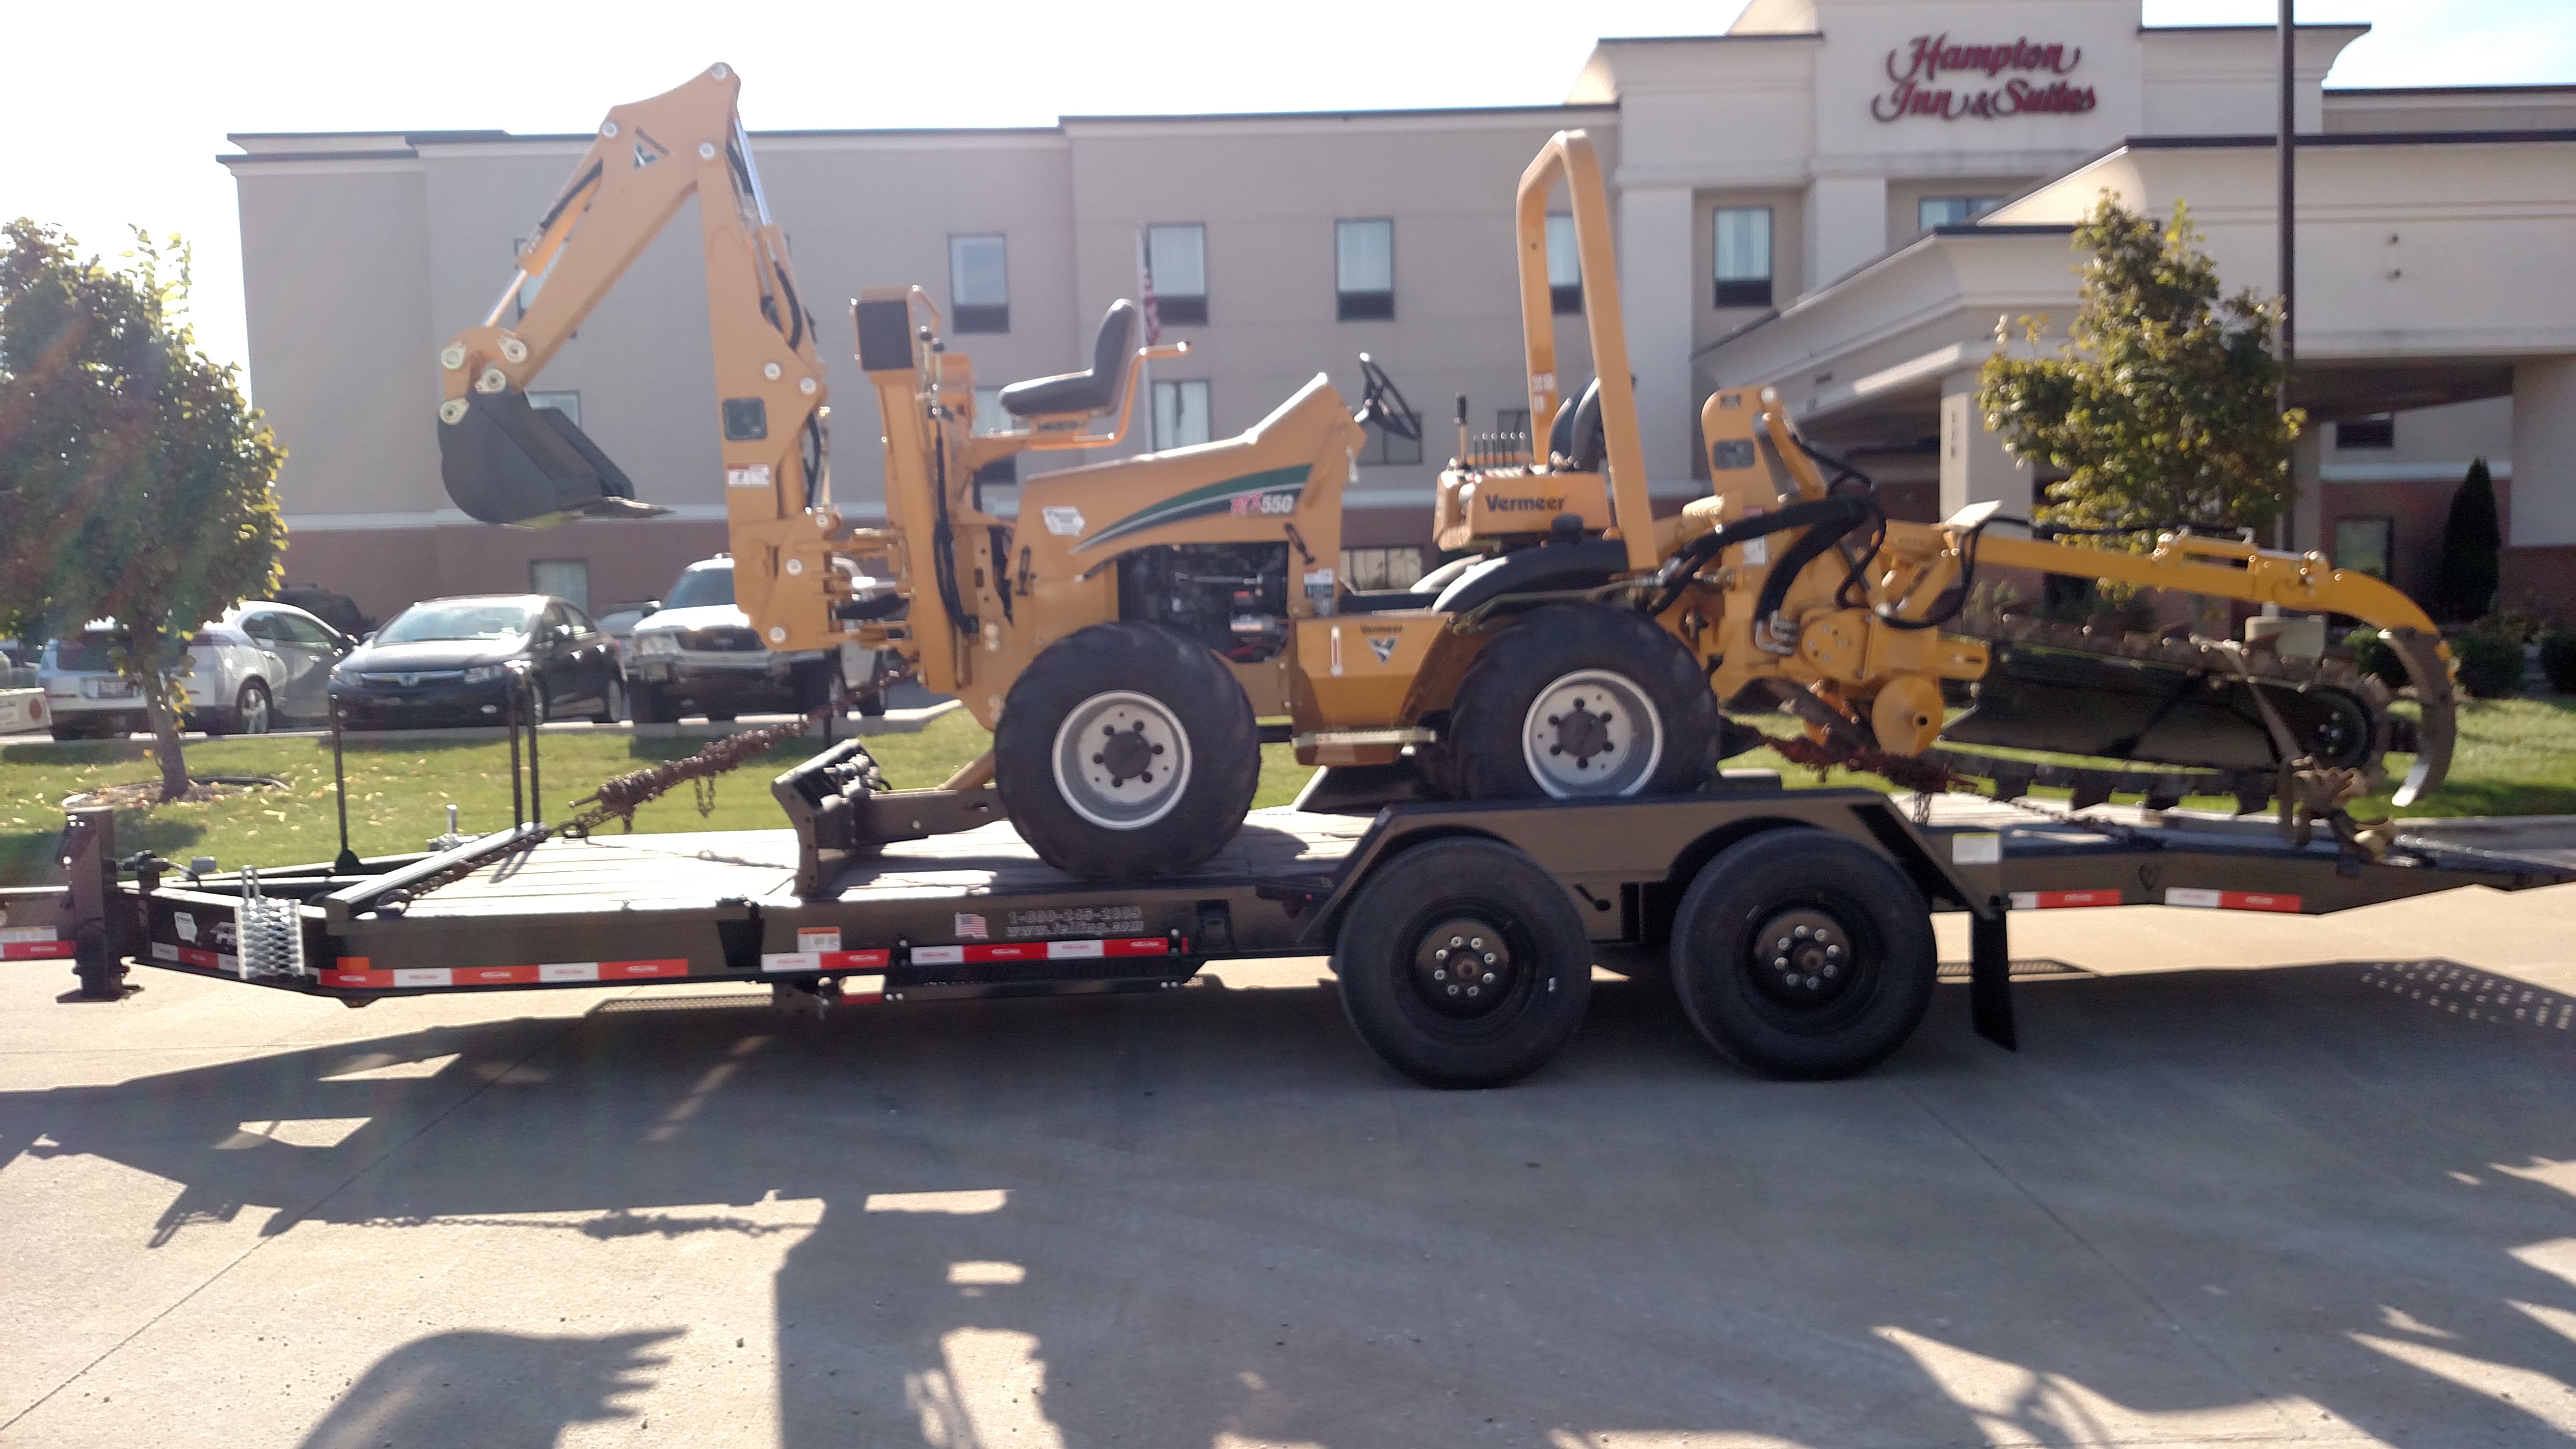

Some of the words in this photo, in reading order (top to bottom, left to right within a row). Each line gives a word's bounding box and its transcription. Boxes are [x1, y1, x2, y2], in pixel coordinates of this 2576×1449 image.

[1885, 31, 2081, 82] Hampton
[1871, 79, 1969, 123] Inn
[1969, 90, 1993, 119] &
[1992, 78, 2097, 117] Suites
[1485, 493, 1565, 512] Vermeer
